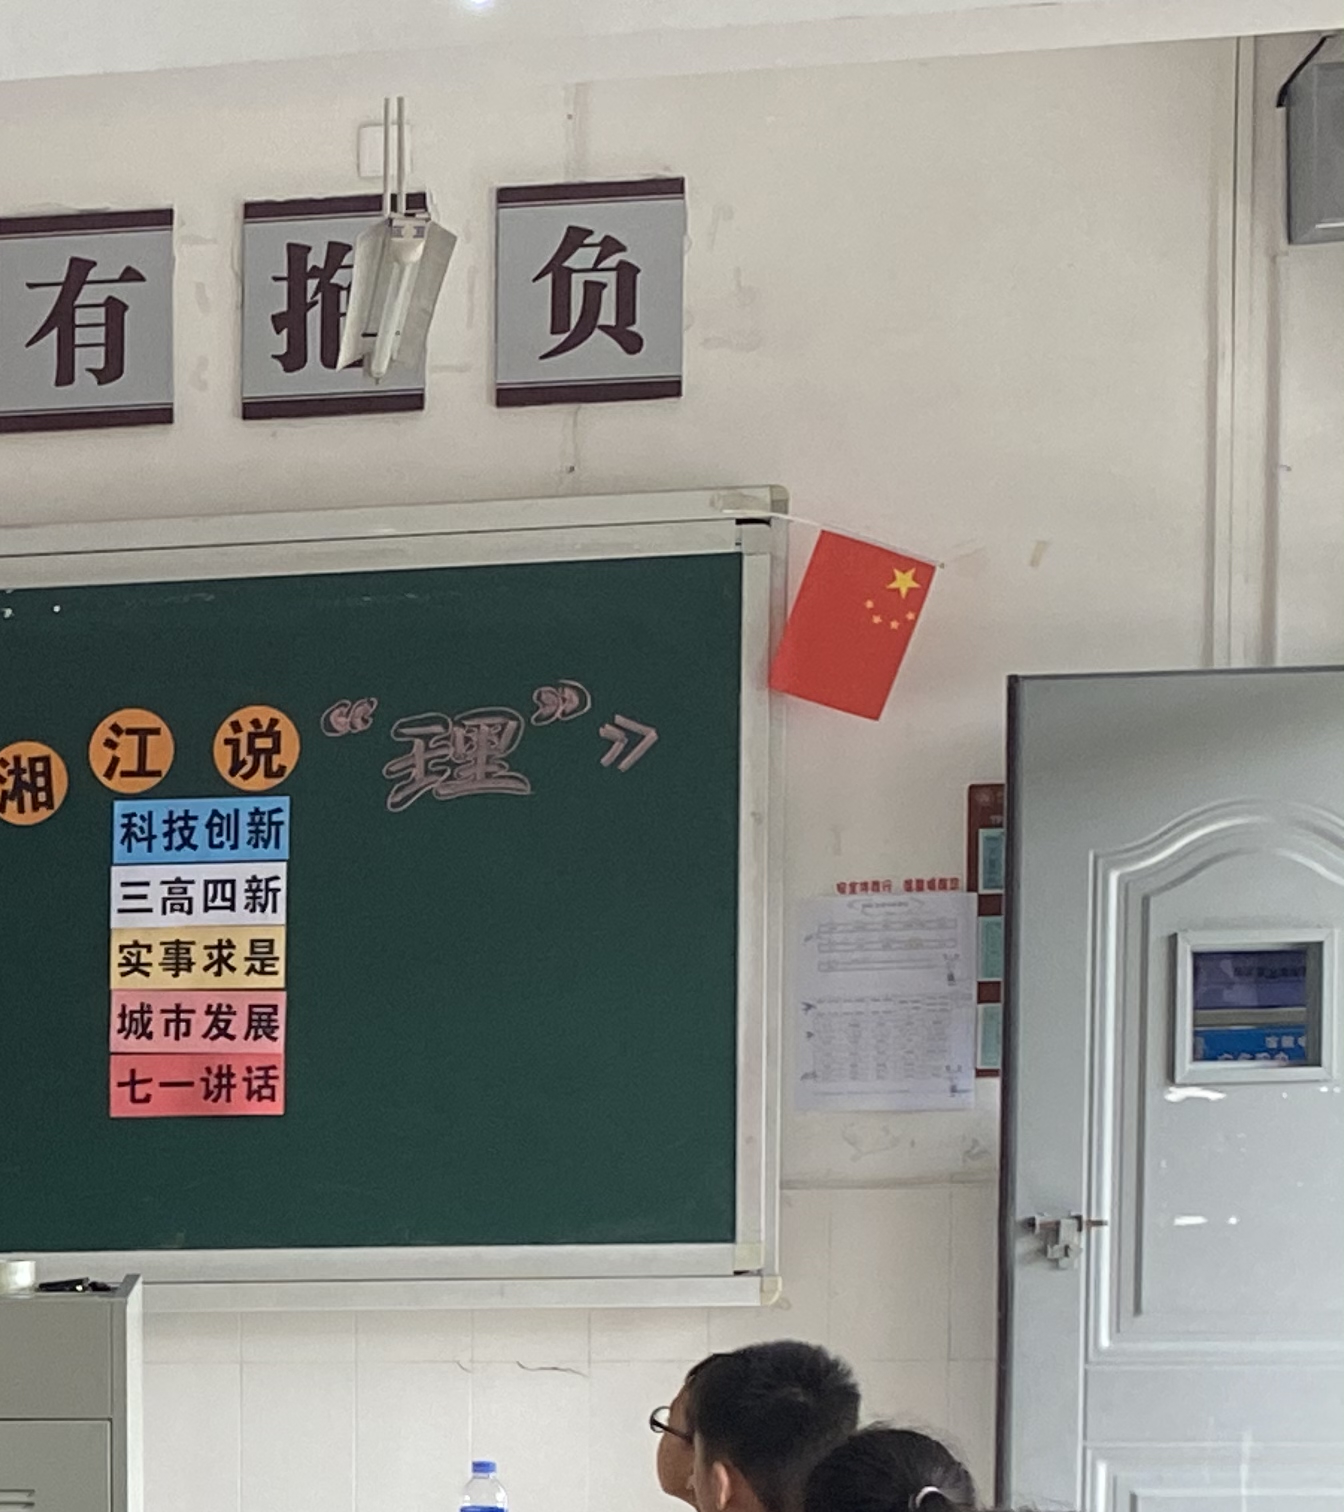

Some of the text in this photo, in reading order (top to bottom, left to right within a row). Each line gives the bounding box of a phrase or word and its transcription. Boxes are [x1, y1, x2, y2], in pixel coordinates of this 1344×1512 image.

[119, 804, 286, 855] 科技创新
[117, 875, 282, 917] 三高四新
[117, 937, 281, 978] 实事求是
[117, 1002, 281, 1045] 城市发展
[117, 1063, 280, 1106] 七一讲话
